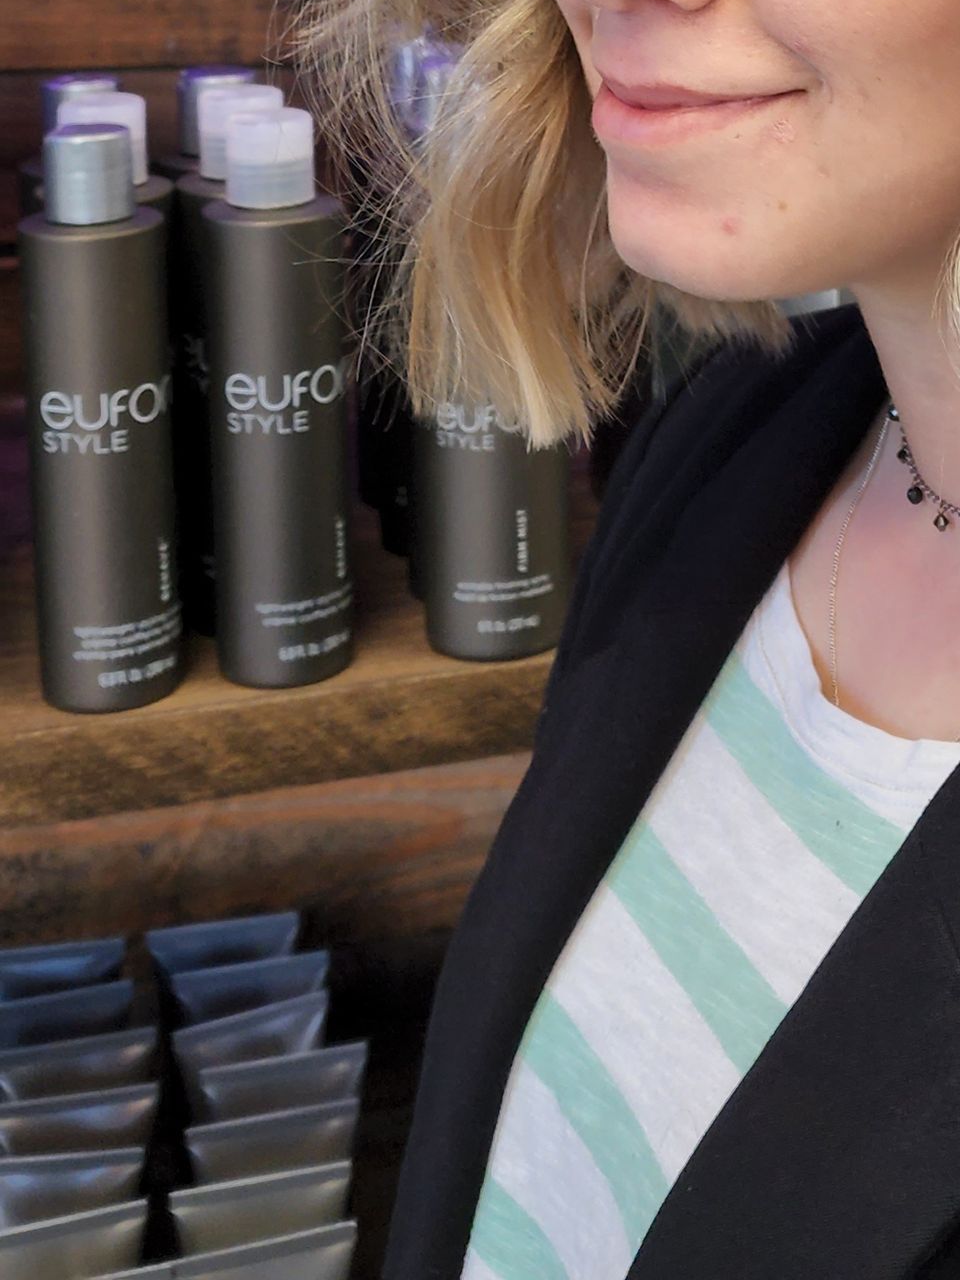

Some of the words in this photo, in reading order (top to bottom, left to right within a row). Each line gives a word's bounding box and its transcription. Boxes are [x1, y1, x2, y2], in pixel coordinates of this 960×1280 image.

[227, 410, 309, 435] STYLE
[43, 429, 129, 455] STYLE
[436, 431, 495, 451] STYLE
